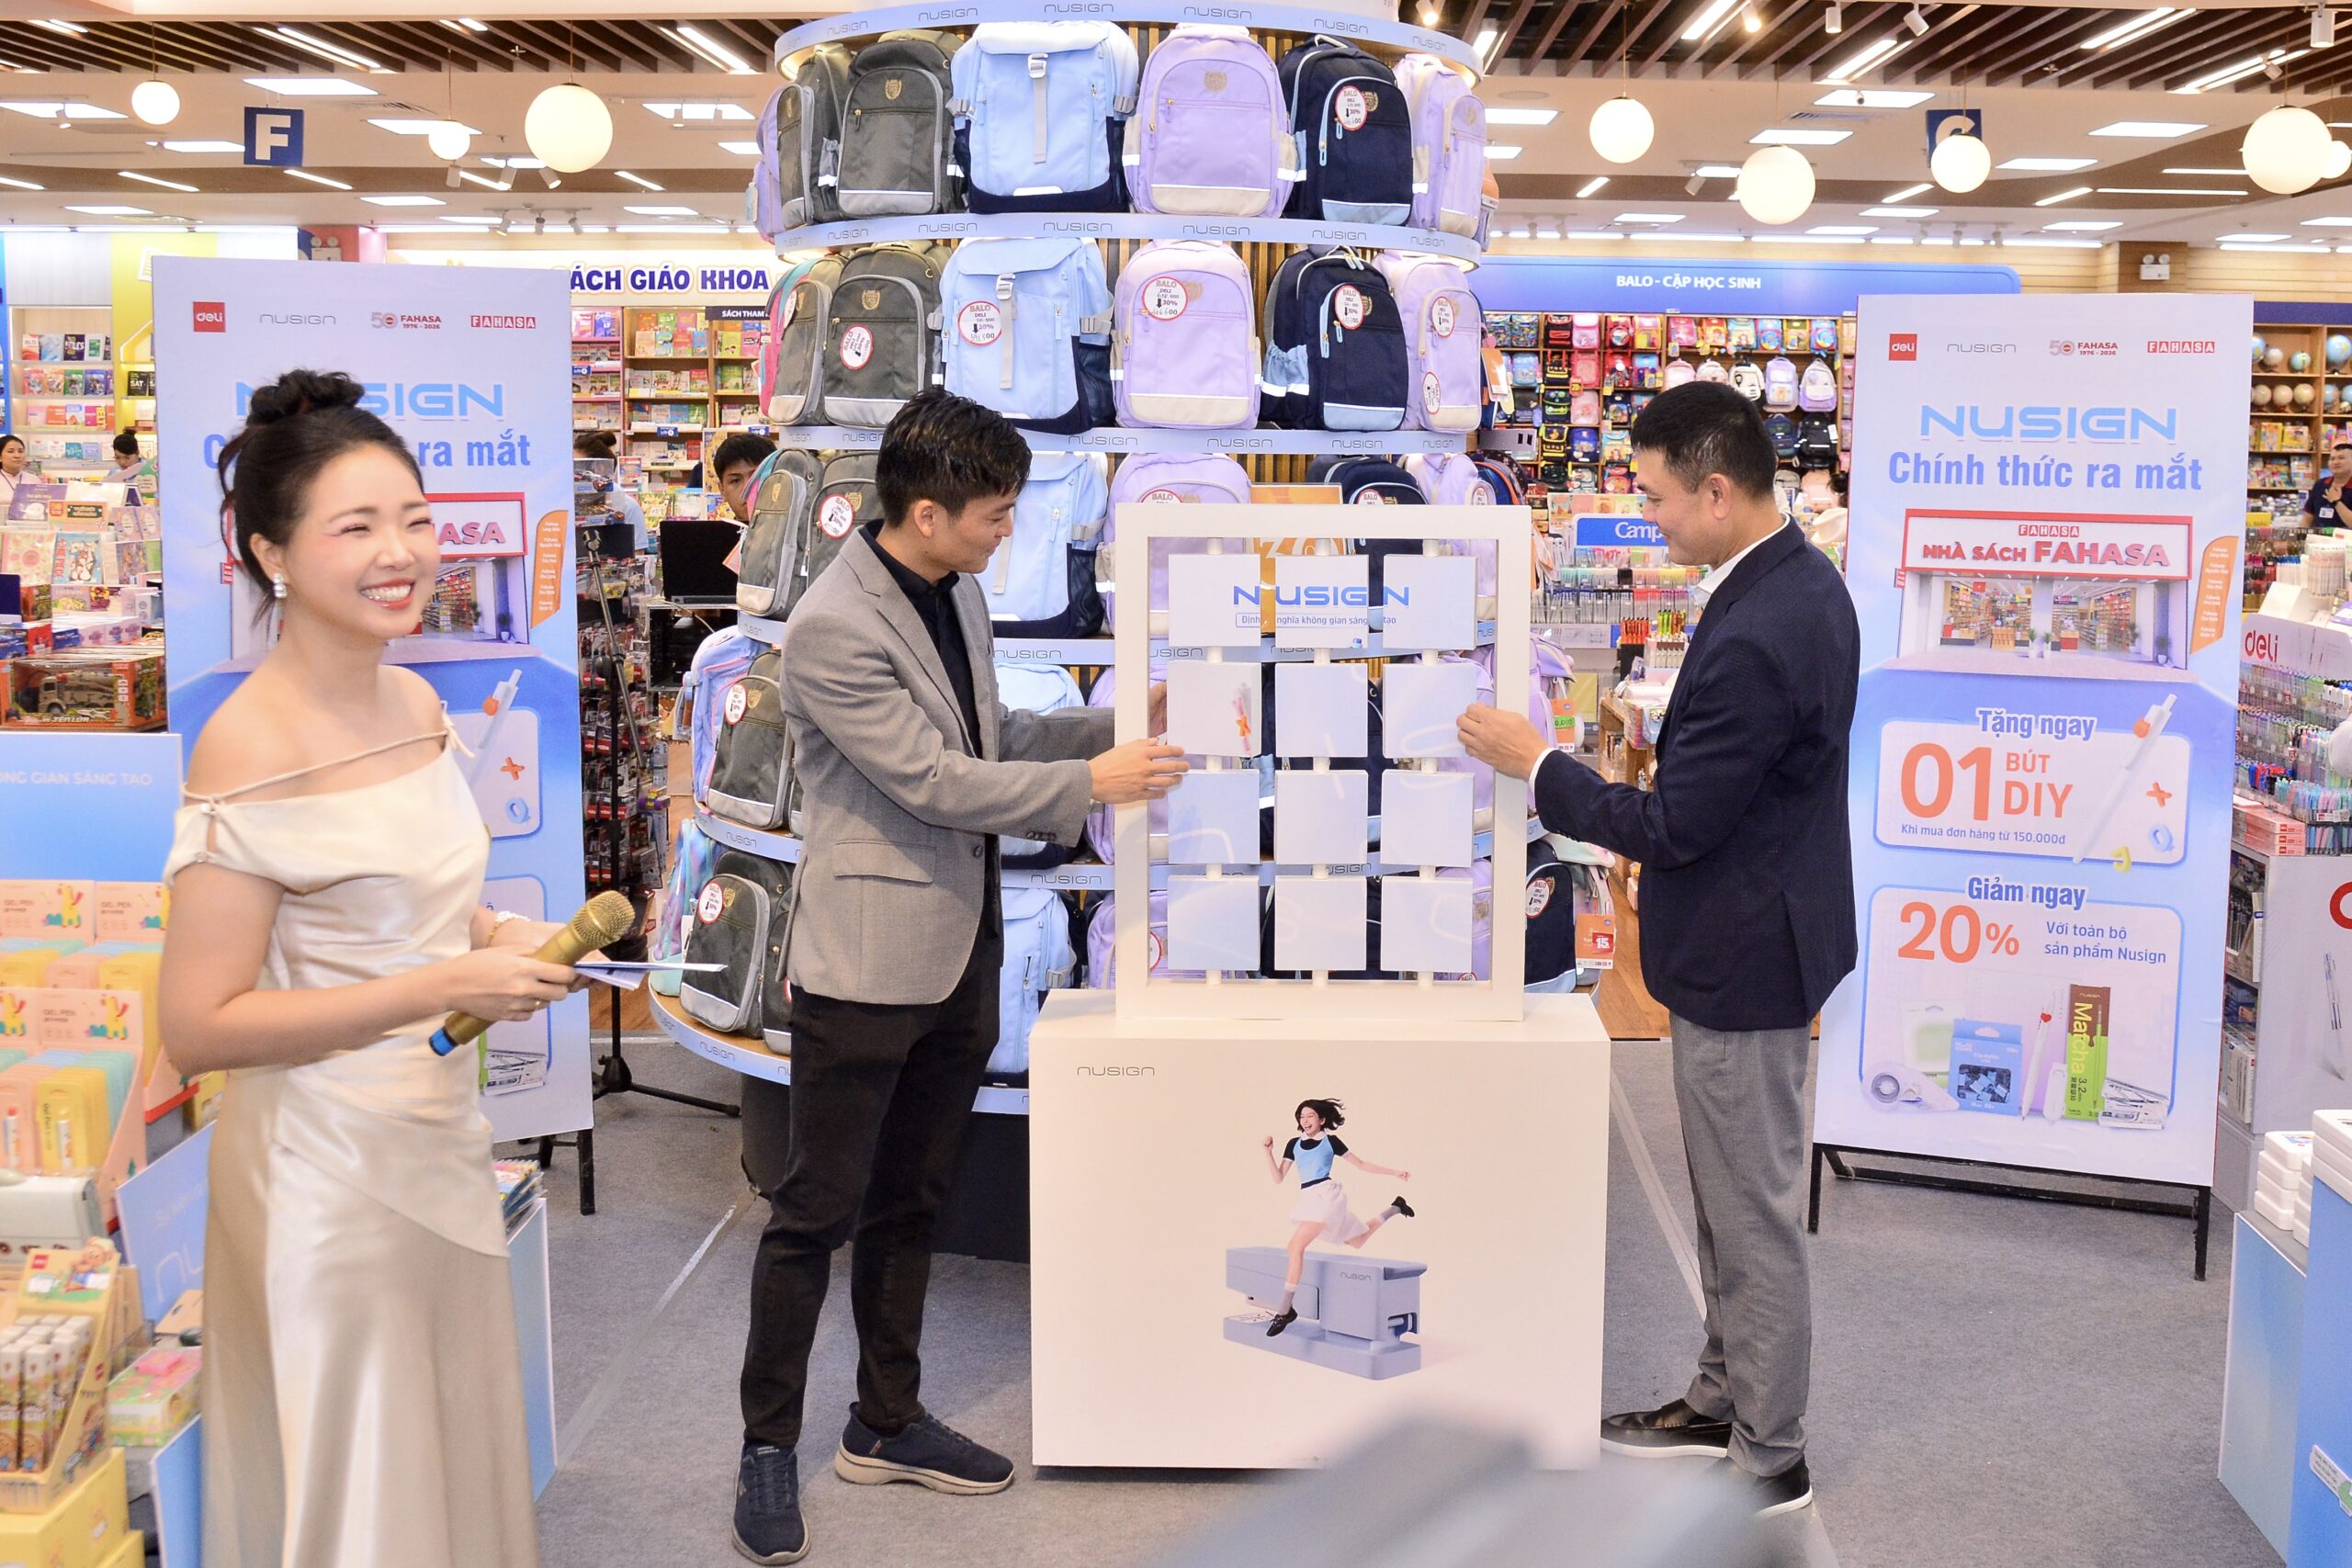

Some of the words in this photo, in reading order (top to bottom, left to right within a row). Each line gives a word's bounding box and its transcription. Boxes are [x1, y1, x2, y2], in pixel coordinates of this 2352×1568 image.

[254, 114, 290, 161] F
[571, 265, 621, 291] ÁCH
[629, 265, 690, 290] GIÁO
[700, 269, 770, 290] KHOA
[1616, 276, 1653, 288] BALO
[1662, 273, 1691, 291] CẶP
[1694, 276, 1724, 291] HỌC
[1728, 276, 1761, 289] SINH
[195, 310, 223, 323] deli
[401, 314, 442, 324] FAHASA
[470, 315, 536, 329] FAHASA
[721, 309, 741, 318] SÁCH
[1892, 342, 1915, 353] deli
[2077, 342, 2119, 350] FAHASA
[2147, 341, 2215, 354] FAHASA
[236, 382, 503, 417] SIGN
[1920, 405, 2177, 441] NUSIGN
[418, 442, 453, 467] ra
[467, 428, 531, 467] mắt
[1889, 452, 1984, 485] Chính
[1998, 455, 2073, 488] thức
[2086, 462, 2121, 489] ra
[2135, 452, 2202, 491] mắt
[1614, 521, 1664, 543] Camp
[2018, 524, 2080, 538] FAHASA
[1923, 541, 1966, 560] NHÀ
[1973, 542, 2027, 562] SÁCH
[2034, 540, 2170, 567] FAHASA
[1233, 585, 1409, 606] NUSIGN
[1241, 615, 1260, 625] Định
[1301, 616, 1328, 626] không
[1329, 617, 1347, 626] gian
[1349, 616, 1367, 626] sáng
[1383, 616, 1396, 626] tạo
[1149, 648, 1204, 658] USIGN
[2245, 629, 2278, 663] deli
[1978, 710, 2032, 739] Tặng
[2041, 715, 2095, 741] ngay
[2006, 751, 2052, 774] BÚT
[1900, 742, 1993, 821] 01
[2004, 781, 2074, 818] DIY
[1901, 823, 1918, 835] Khi
[1920, 828, 1943, 837] mua
[1946, 827, 1966, 838] đơn
[1969, 829, 1996, 841] hàng
[1998, 830, 2010, 841] từ
[2013, 831, 2066, 845] 150.000đ
[1968, 875, 2022, 902] Giảm
[2031, 885, 2086, 910] ngay
[1897, 901, 2019, 964] 20%
[2046, 921, 2068, 936] Với
[2073, 923, 2104, 938] toàn
[2109, 925, 2127, 941] bộ
[2044, 942, 2069, 956] sản
[2073, 942, 2113, 959] phẩm
[2118, 947, 2166, 964] Nusign
[2070, 1002, 2094, 1074] Matcha
